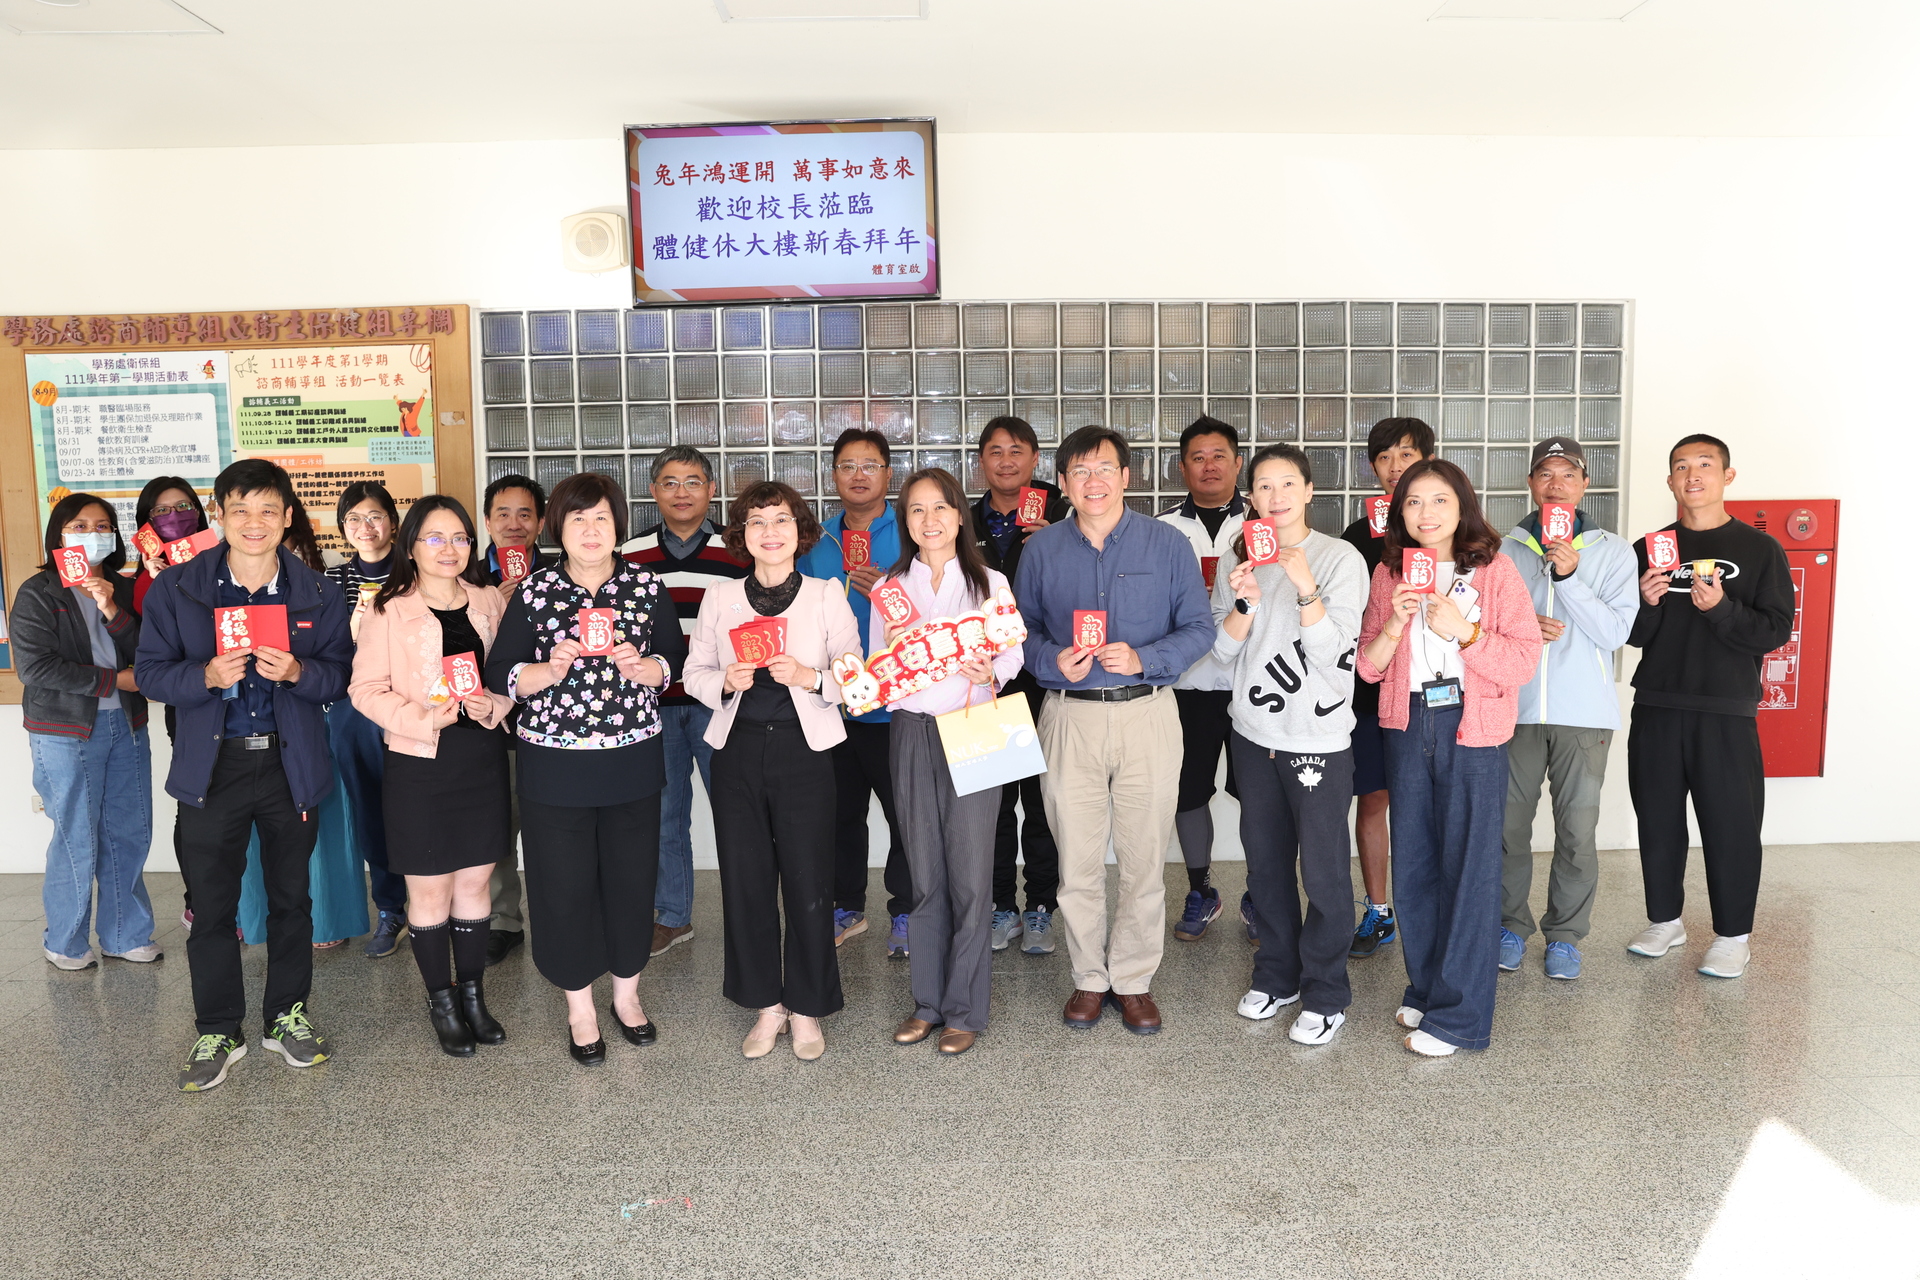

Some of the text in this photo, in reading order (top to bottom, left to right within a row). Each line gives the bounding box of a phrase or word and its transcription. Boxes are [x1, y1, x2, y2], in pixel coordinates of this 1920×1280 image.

[653, 156, 915, 187] 兔年鴻運開 萬事如意來
[695, 191, 874, 223] 歡迎校長蒞臨
[652, 226, 921, 261] 體健休大樓新春拜年
[871, 263, 921, 276] 體育室啟
[92, 357, 161, 370] 學務處衛保組
[271, 353, 389, 370] 111學年度第1學期
[64, 371, 189, 385] 111學年第一學期活動表
[255, 372, 405, 390] 諮商輔導組 活動一覽表
[35, 387, 56, 397] 8-9月
[58, 437, 80, 446] 08/31
[59, 447, 81, 456] 09/07
[60, 458, 95, 467] 09/07-08
[61, 468, 95, 478] 09/23-24
[1290, 756, 1327, 768] CANADA
